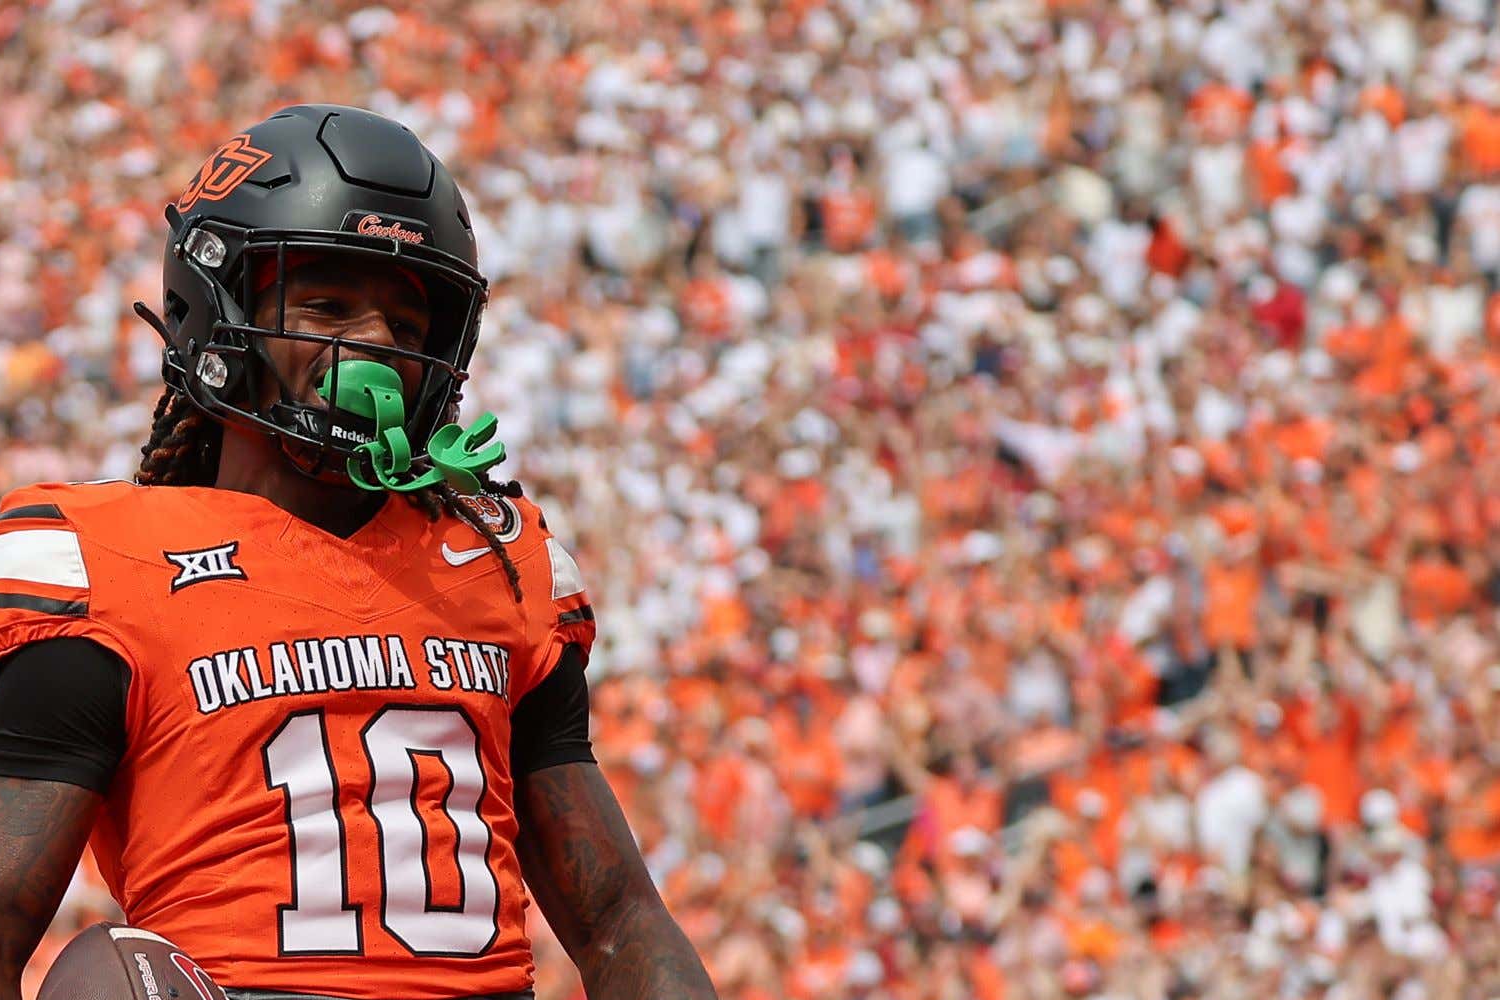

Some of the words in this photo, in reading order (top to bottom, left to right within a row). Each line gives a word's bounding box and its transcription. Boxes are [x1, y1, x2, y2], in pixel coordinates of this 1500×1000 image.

[358, 214, 424, 244] Cowboys
[164, 541, 247, 593] XII
[187, 635, 416, 715] OKLAHOMA
[422, 636, 509, 701] STATE
[262, 702, 501, 957] 10
[134, 952, 158, 996] VAPOR
